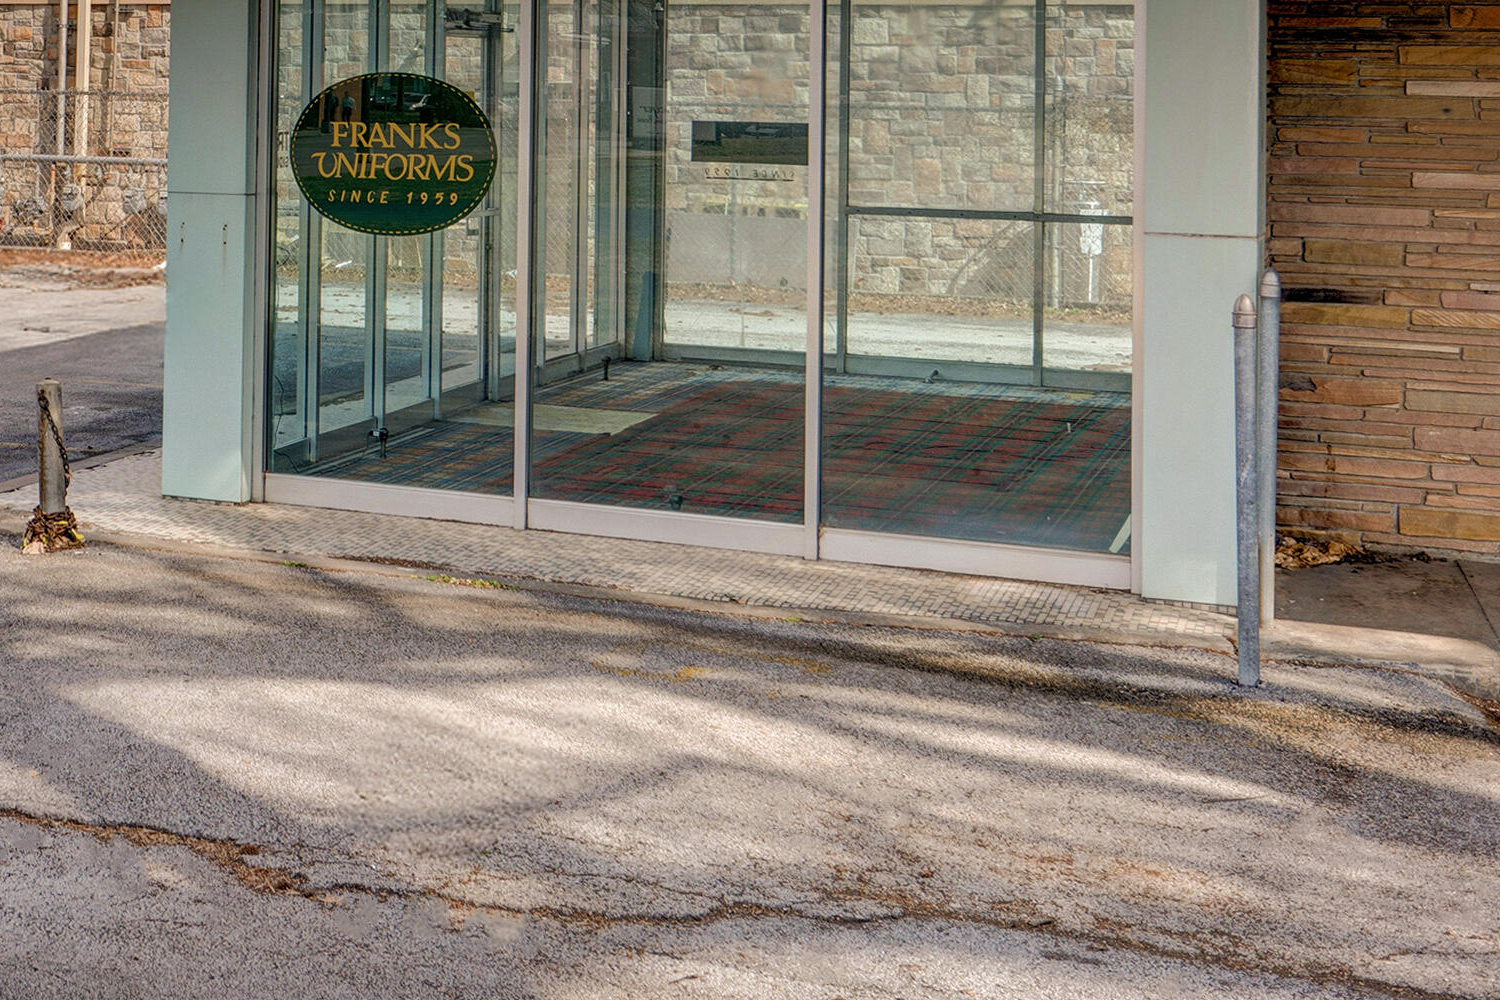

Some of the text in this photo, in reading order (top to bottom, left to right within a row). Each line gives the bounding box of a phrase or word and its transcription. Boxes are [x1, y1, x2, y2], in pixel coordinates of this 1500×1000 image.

[330, 121, 461, 150] FRANKS
[310, 152, 475, 182] UNIFORMS
[327, 189, 459, 206] SINCE 1959
